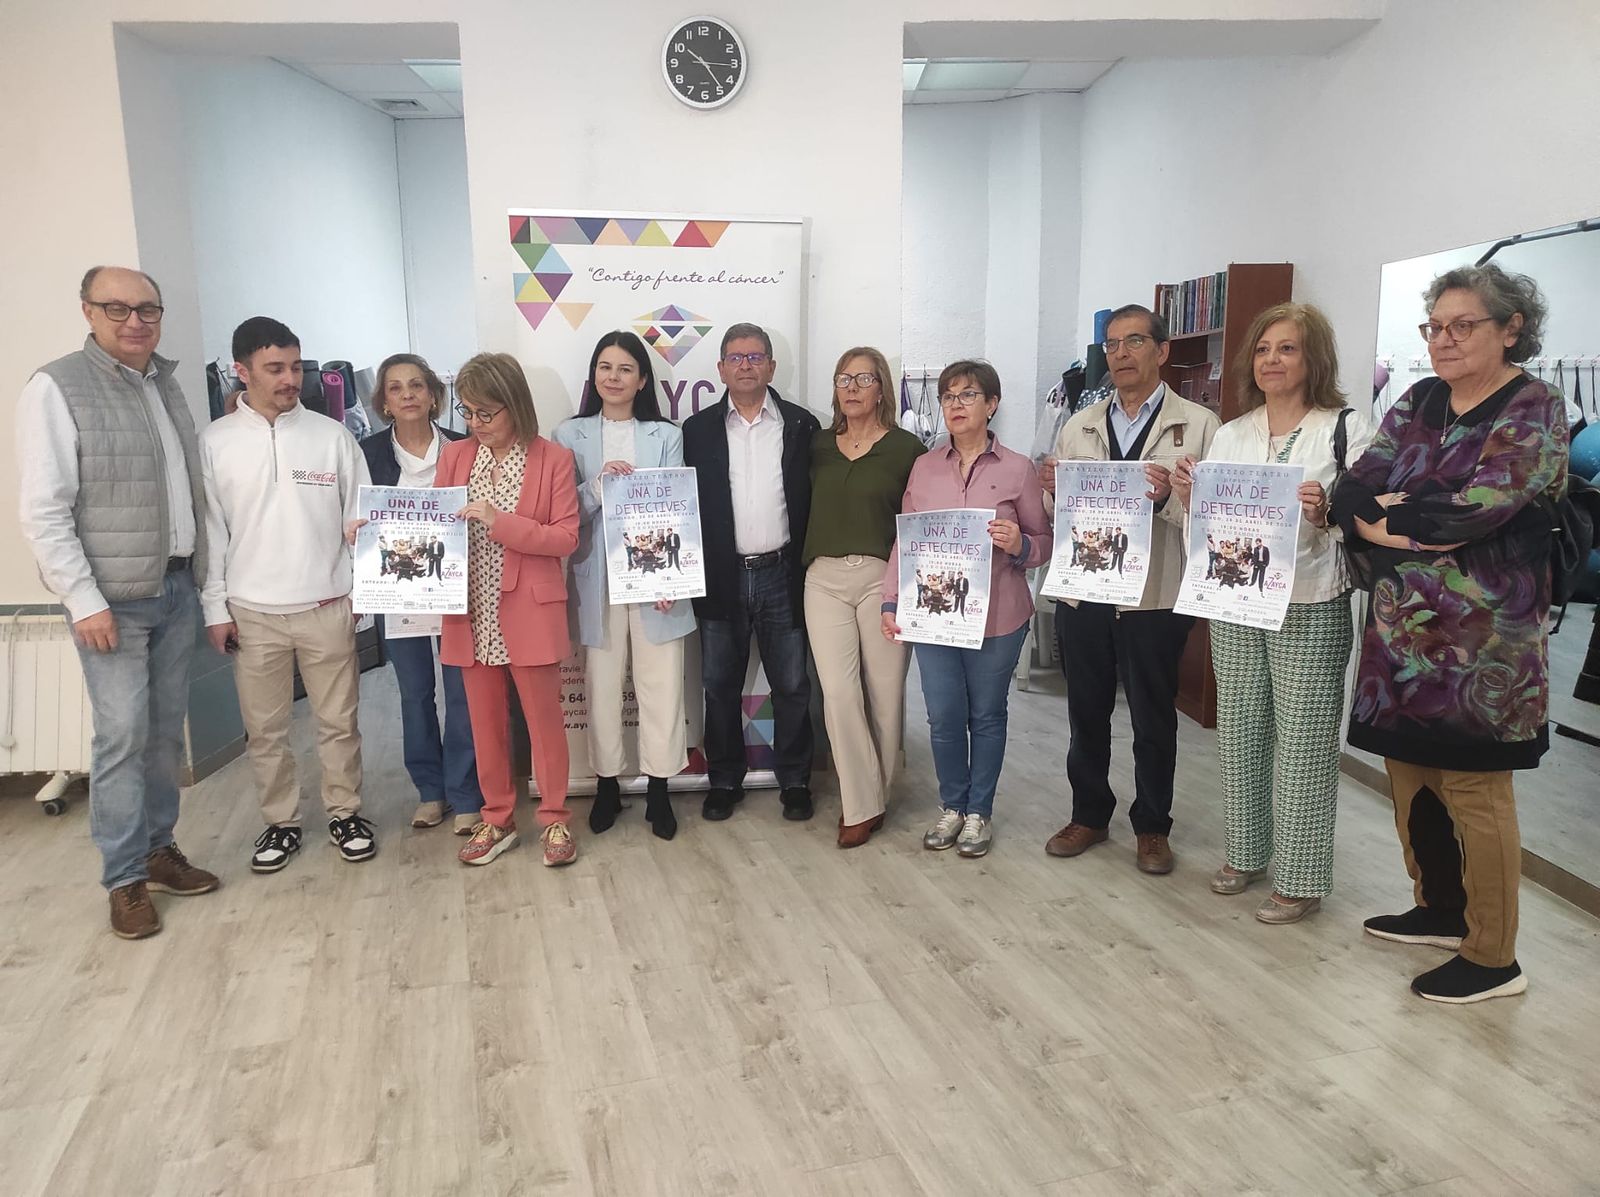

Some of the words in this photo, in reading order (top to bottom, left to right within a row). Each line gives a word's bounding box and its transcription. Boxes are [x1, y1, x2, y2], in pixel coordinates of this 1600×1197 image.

[686, 30, 692, 40] 11
[698, 26, 709, 36] 12
[674, 43, 685, 53] 10
[726, 43, 734, 53] 2
[670, 58, 679, 68] 9
[731, 59, 738, 68] 3
[675, 74, 684, 84] 8
[725, 75, 734, 84] 4
[687, 85, 694, 95] 7
[701, 90, 709, 100] 6
[716, 86, 724, 95] 5
[653, 270, 705, 290] frente
[708, 271, 723, 284] al
[1081, 479, 1104, 492] UNA
[1110, 480, 1127, 492] DE
[627, 487, 651, 499] UNA
[656, 486, 672, 498] DE
[1216, 483, 1243, 498] UNA
[1250, 485, 1270, 499] DE
[387, 499, 415, 509] UNA
[422, 501, 440, 510] DE
[615, 499, 687, 515] DETECTIVES
[1067, 495, 1141, 510] DETECTIVES
[1201, 500, 1286, 520] DETECTIVES
[369, 510, 456, 523] DETECTIVES
[923, 526, 947, 538] UNA
[953, 527, 968, 539] DE
[910, 541, 981, 555] DETECTIVES
